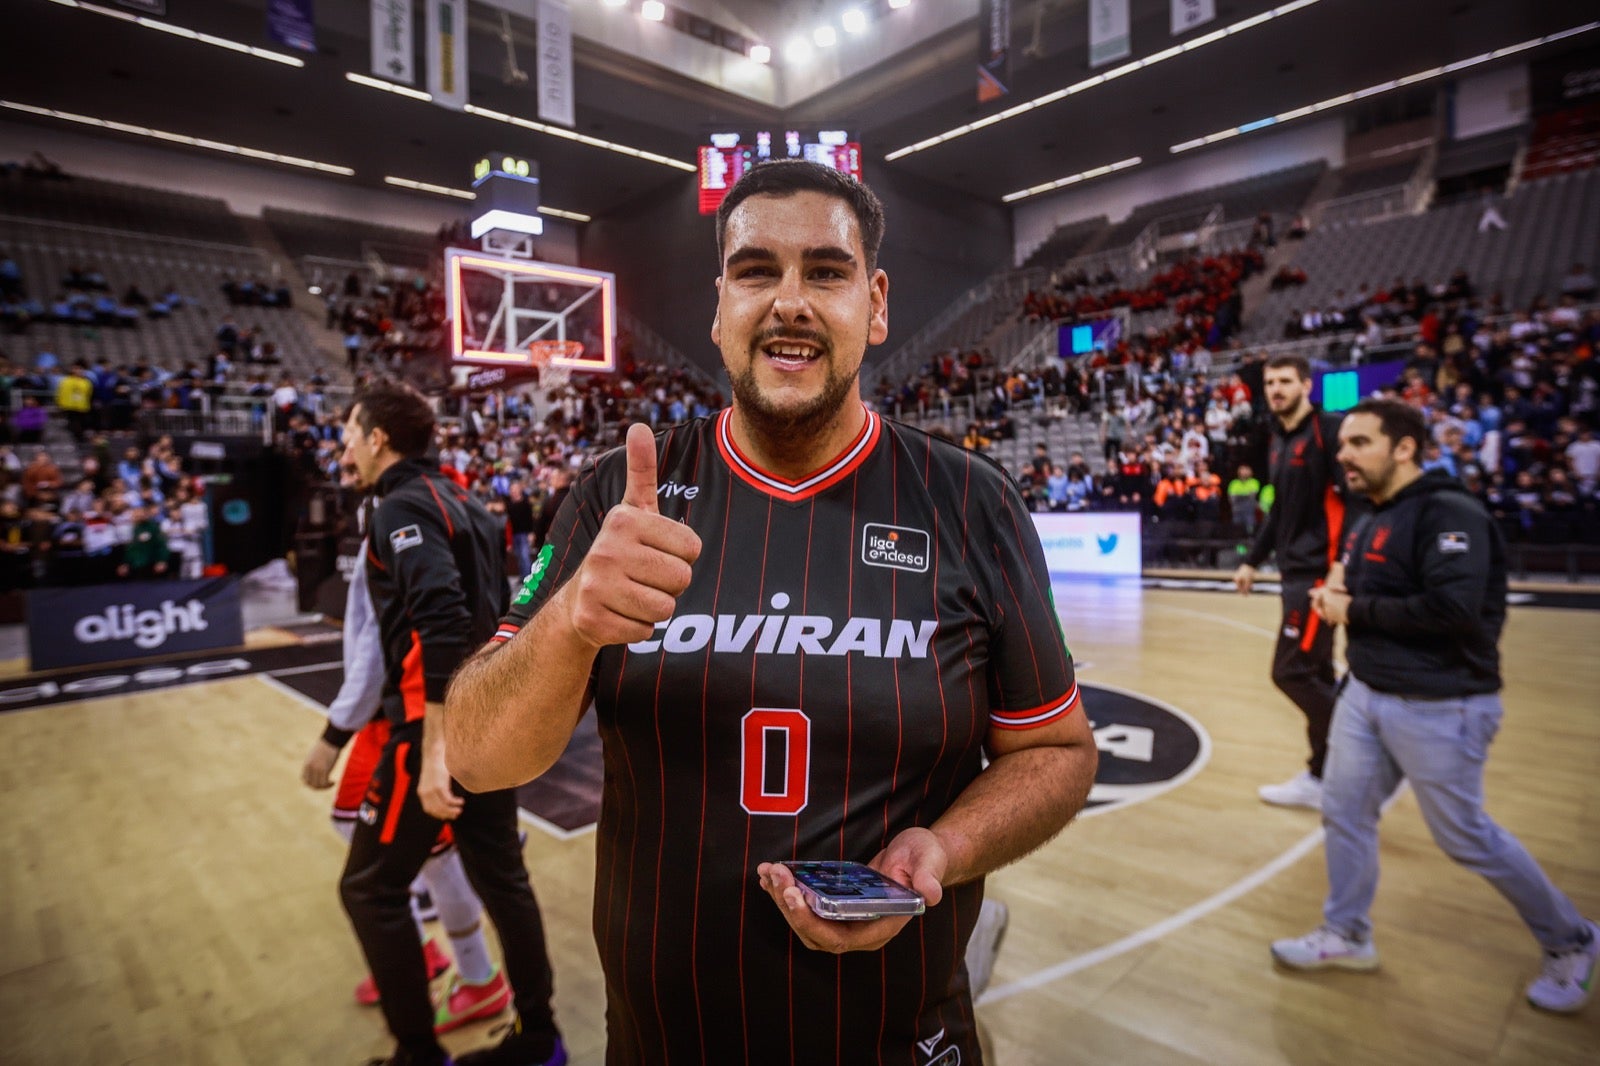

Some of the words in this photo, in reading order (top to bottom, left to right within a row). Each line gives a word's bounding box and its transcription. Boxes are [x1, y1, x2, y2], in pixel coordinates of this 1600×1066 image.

[869, 535, 895, 550] liga
[869, 549, 923, 566] endesa
[740, 707, 811, 816] 0
